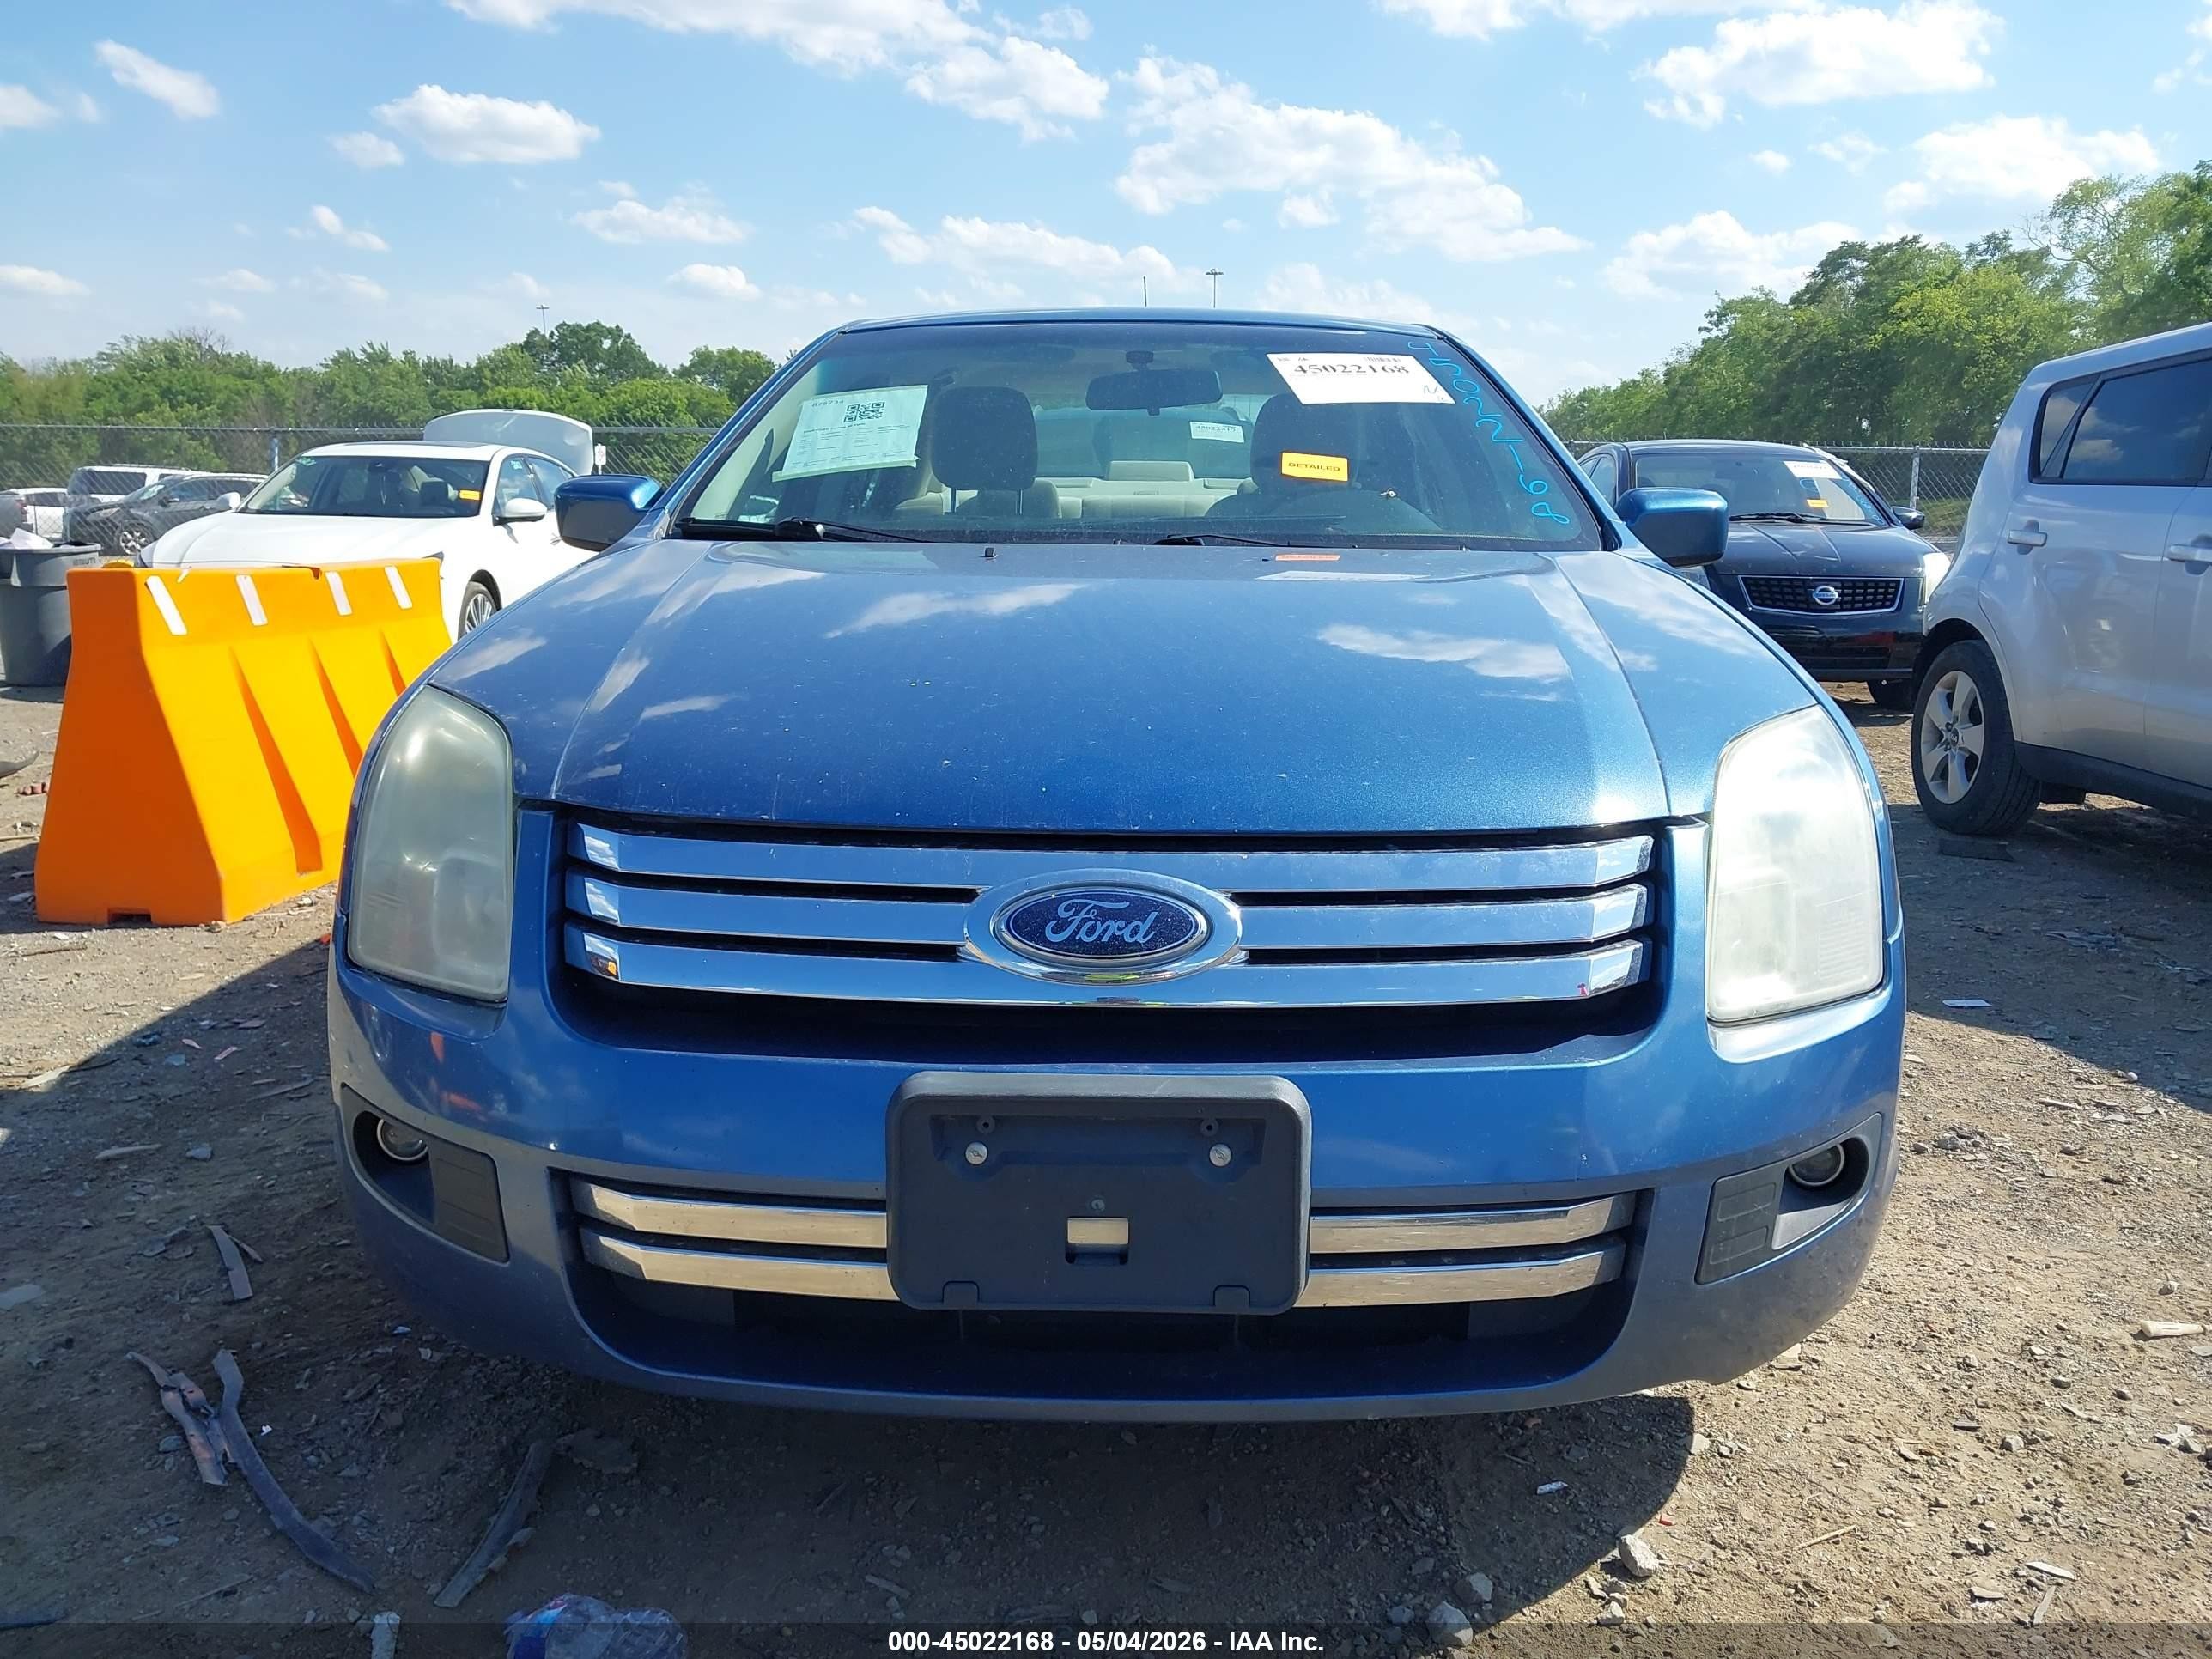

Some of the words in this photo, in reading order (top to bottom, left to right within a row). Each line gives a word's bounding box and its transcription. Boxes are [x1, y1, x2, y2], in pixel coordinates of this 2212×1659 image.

[1293, 364, 1410, 374] 45022168
[1288, 462, 1340, 471] DETAILED
[1045, 898, 1158, 943] Ford
